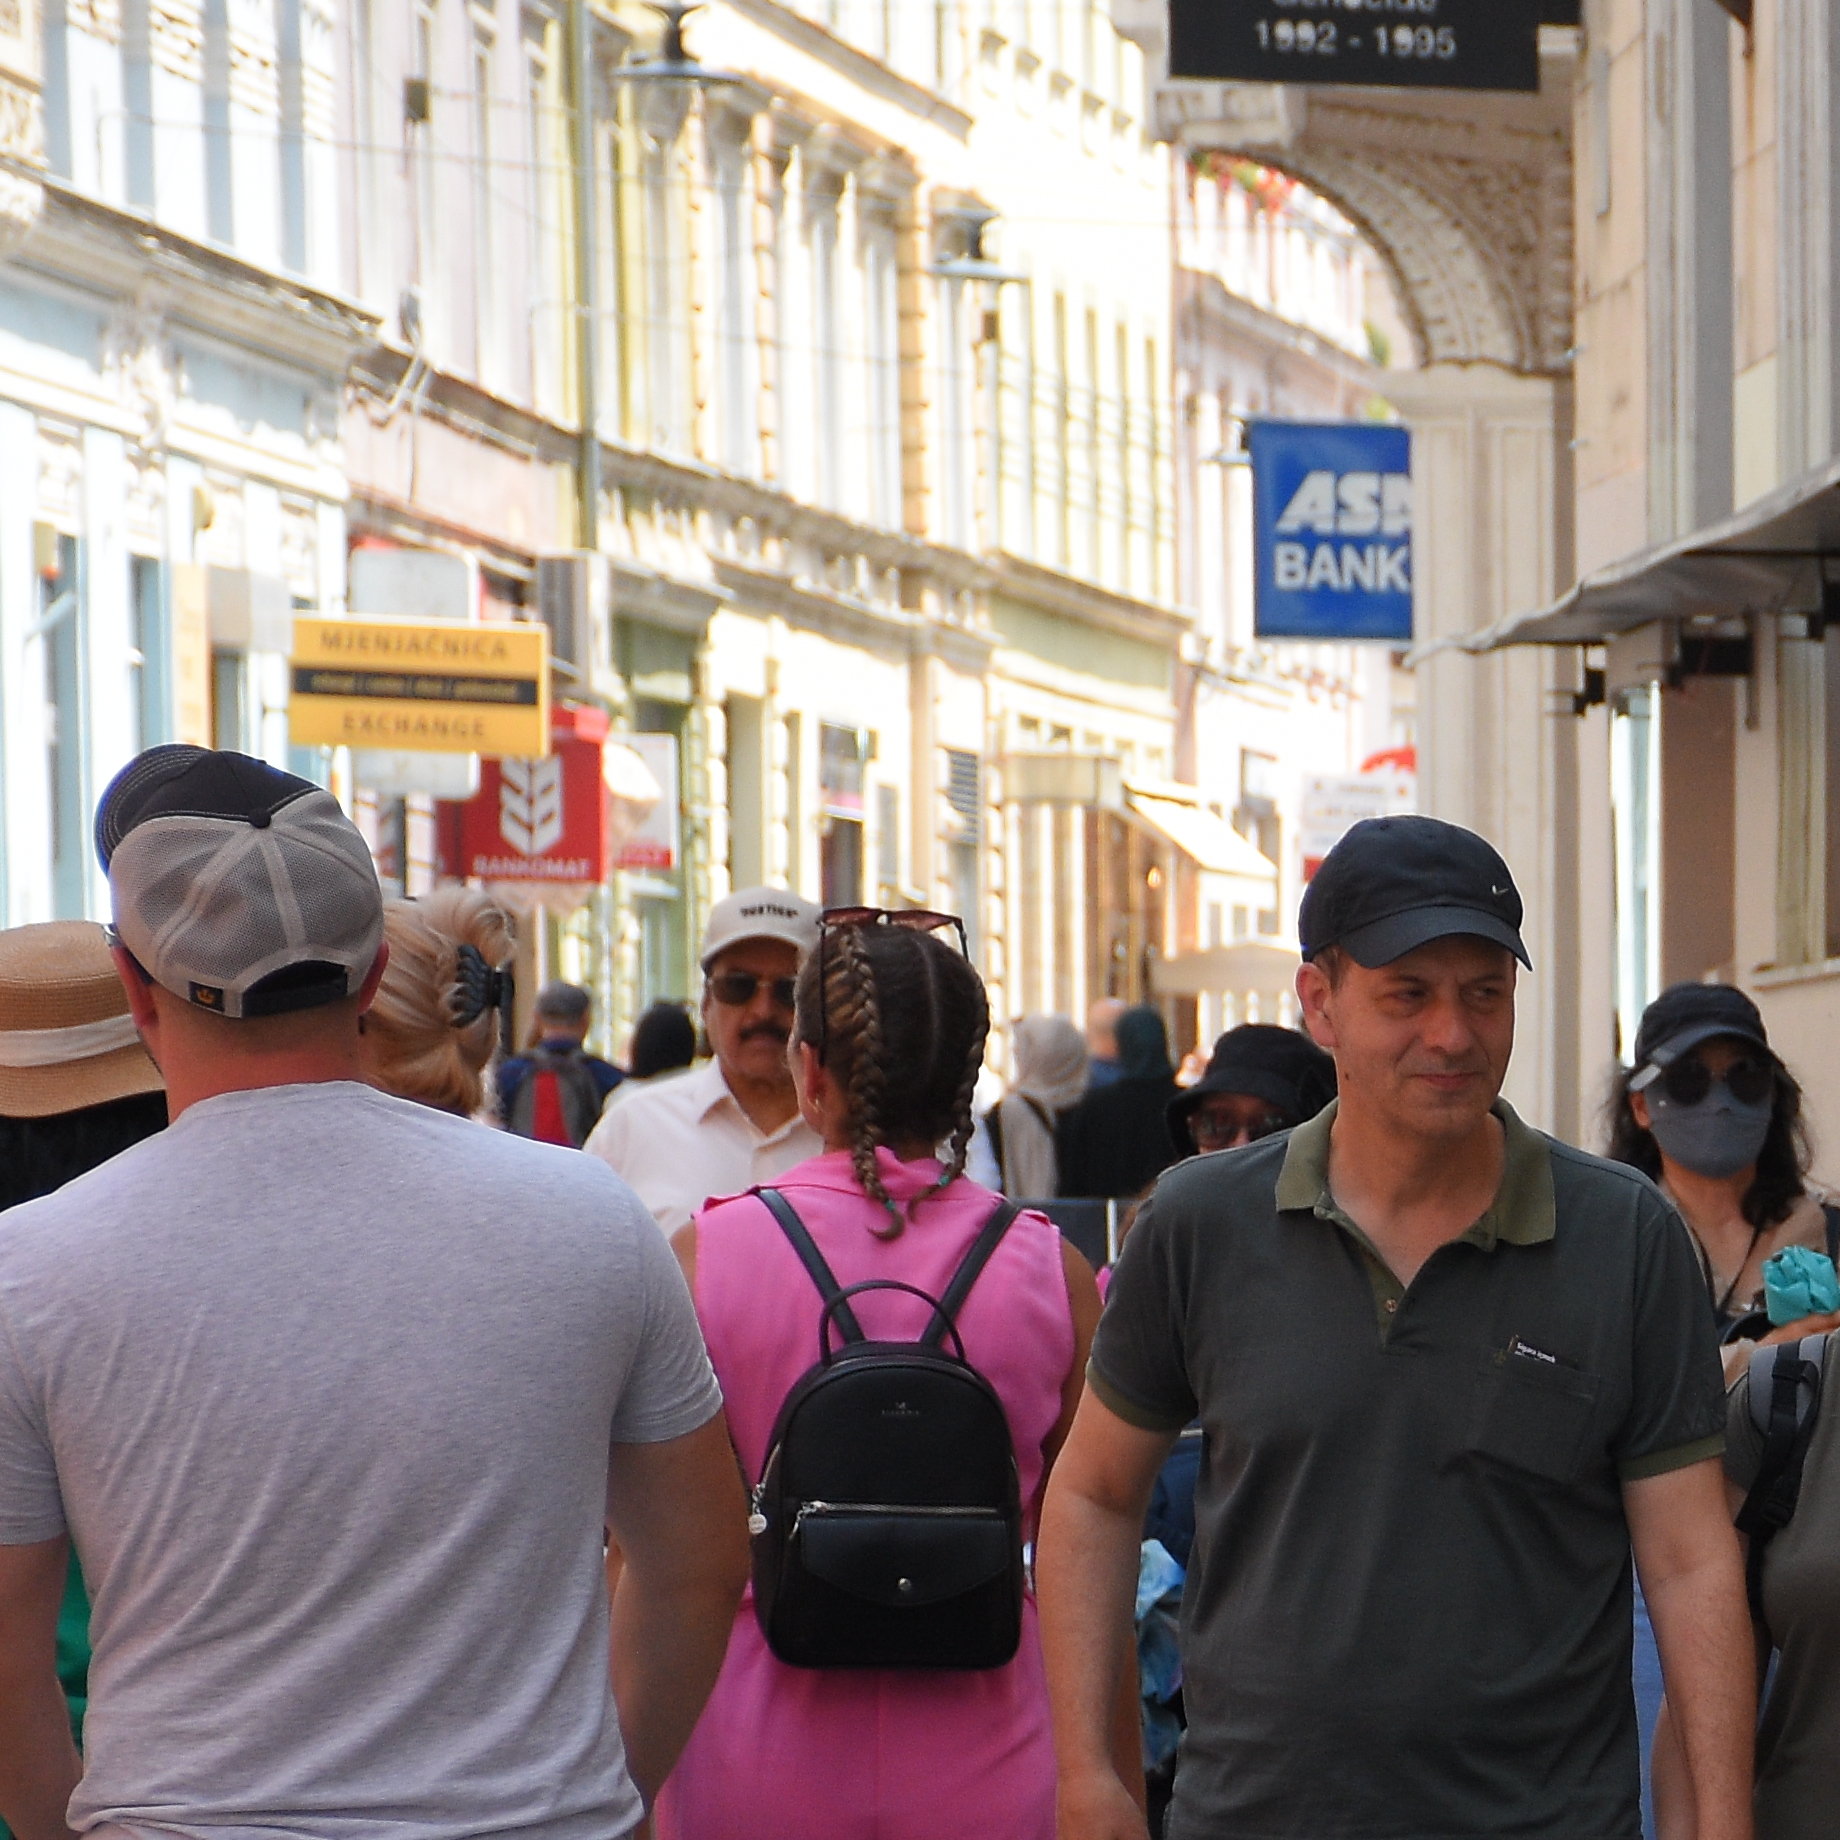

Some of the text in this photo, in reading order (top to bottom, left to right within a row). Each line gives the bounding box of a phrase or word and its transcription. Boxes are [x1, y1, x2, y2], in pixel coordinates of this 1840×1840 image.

[1256, 18, 1338, 55] 1992
[1374, 23, 1458, 61] 1995
[1274, 542, 1410, 595] BANK
[342, 710, 485, 738] EXCHANGE
[472, 853, 591, 882] BANKOMAT
